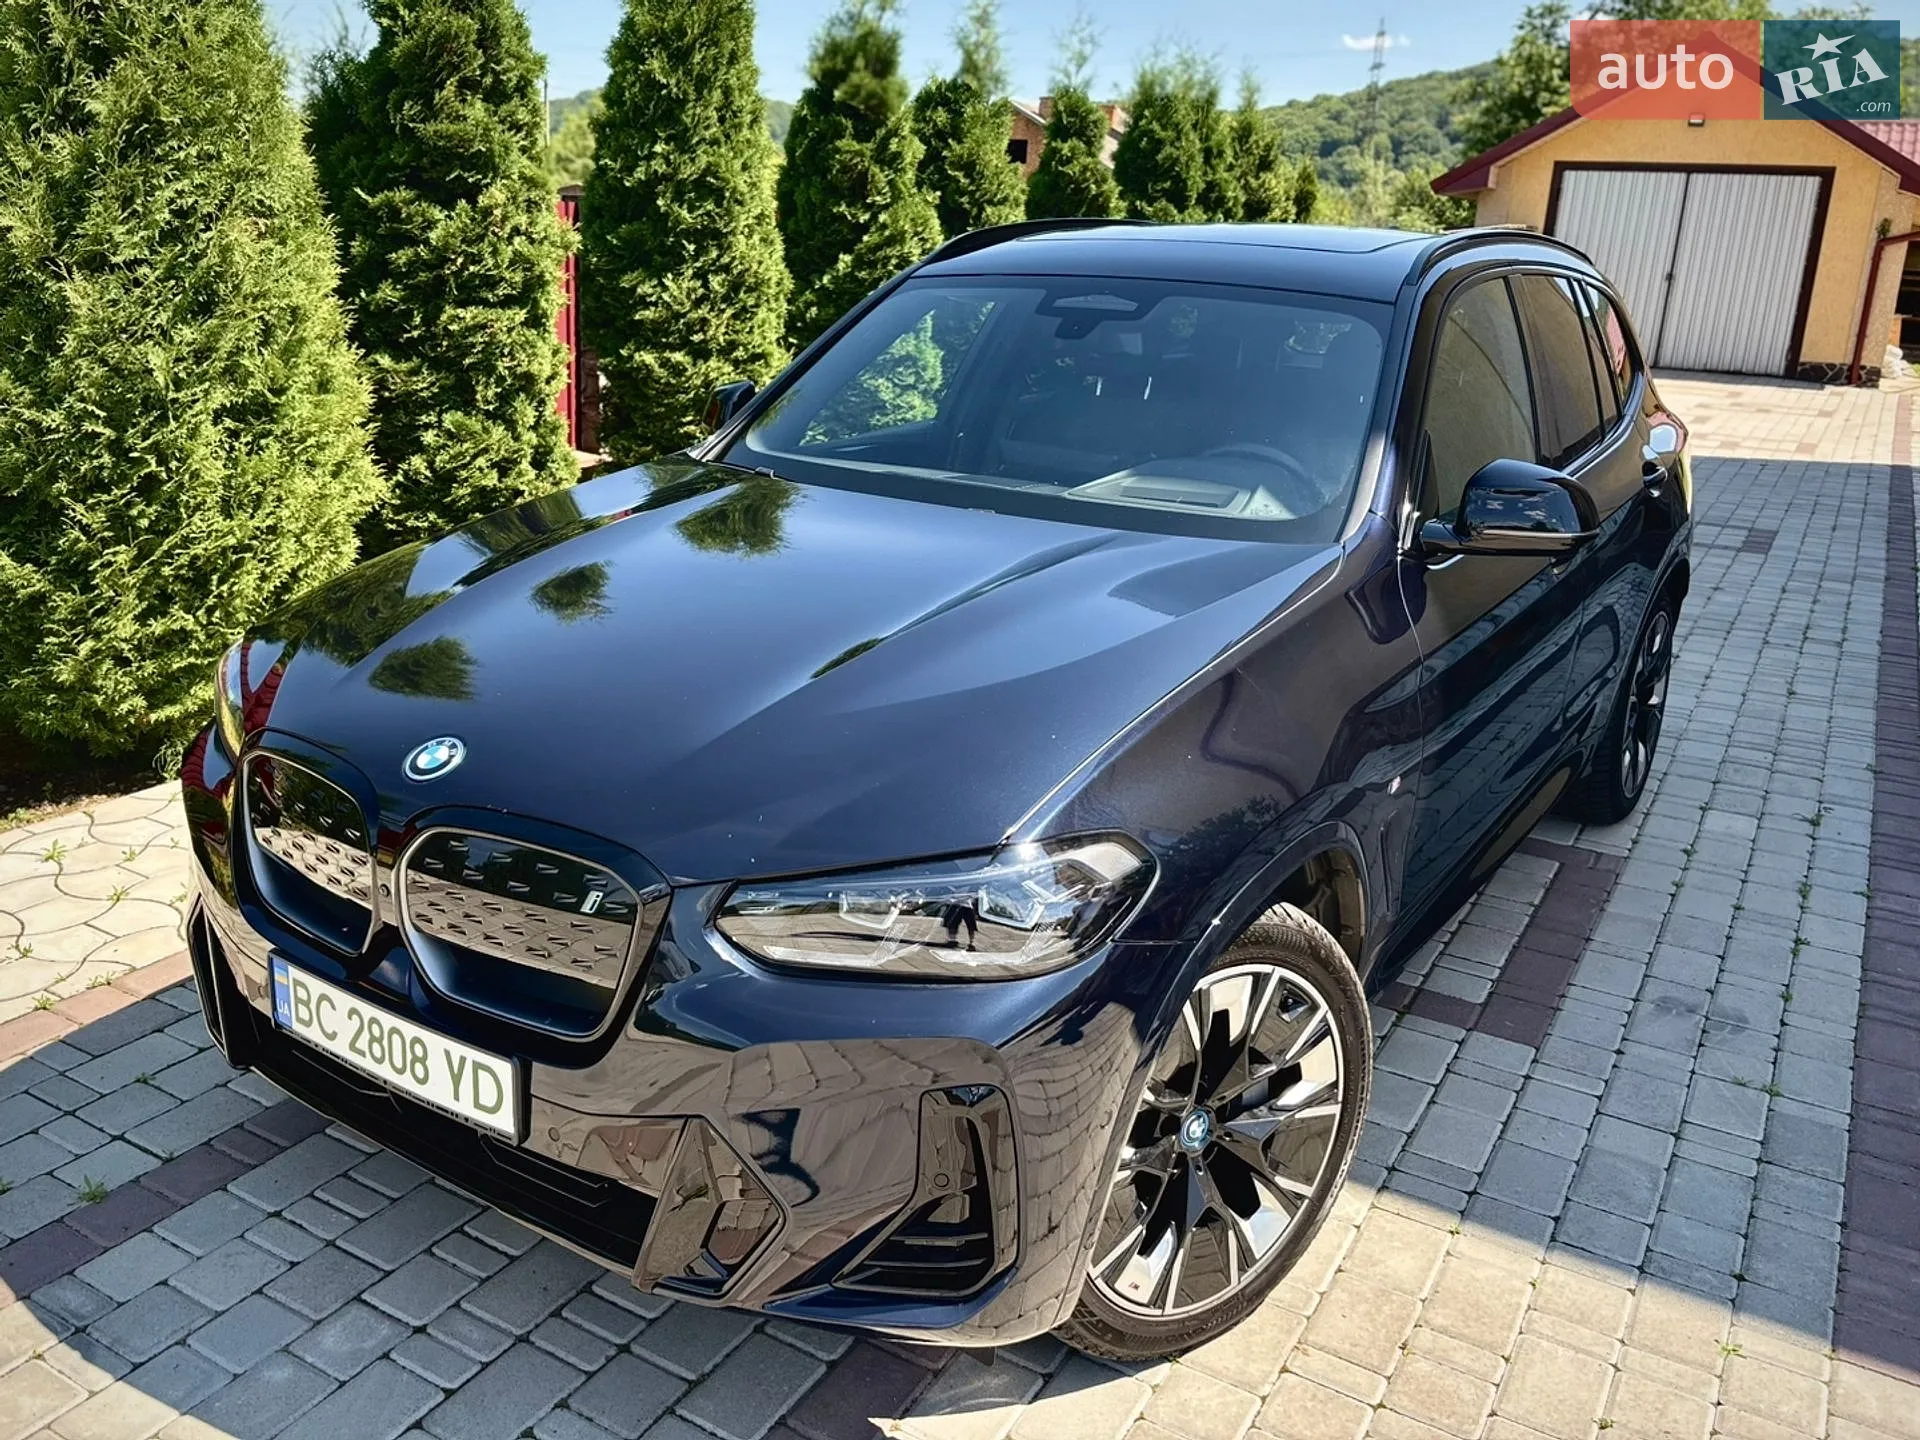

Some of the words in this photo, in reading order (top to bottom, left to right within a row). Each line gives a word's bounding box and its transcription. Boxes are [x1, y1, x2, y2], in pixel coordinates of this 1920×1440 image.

[276, 998, 291, 1017] UA
[292, 977, 338, 1042] BC
[347, 1007, 430, 1086] 2808
[443, 1048, 504, 1115] YD
